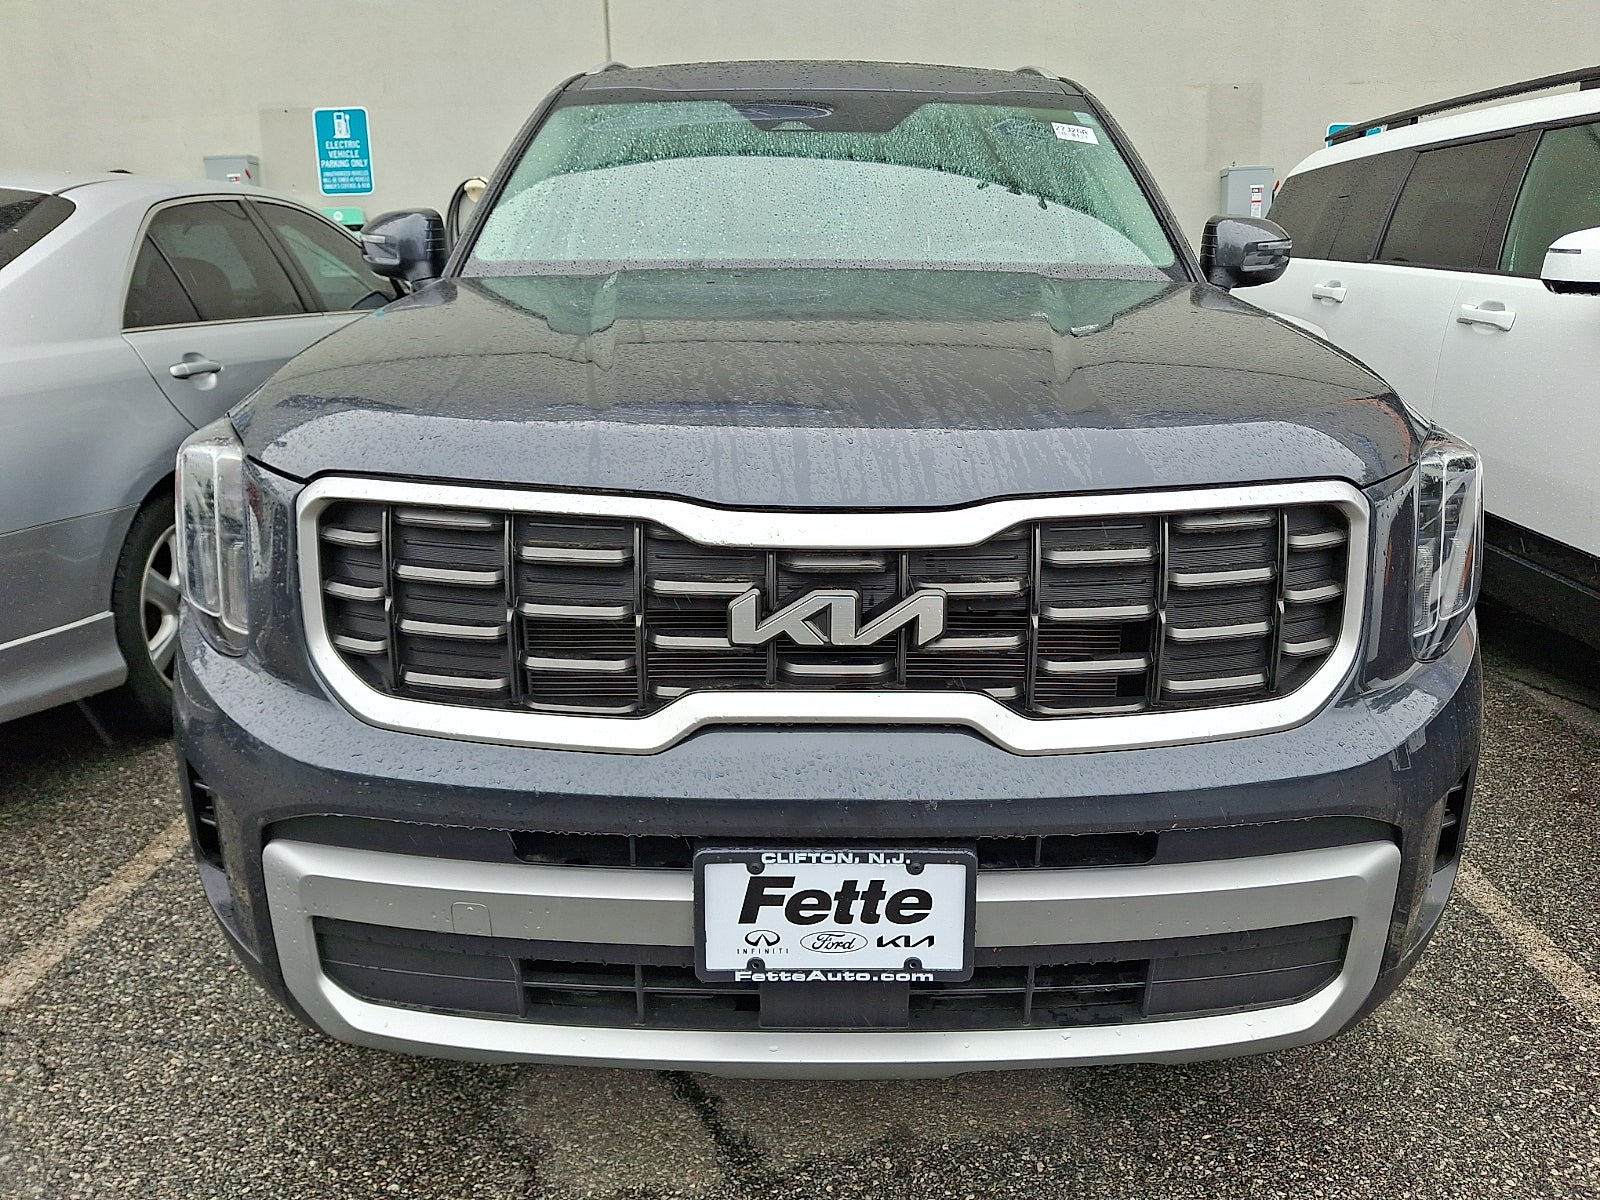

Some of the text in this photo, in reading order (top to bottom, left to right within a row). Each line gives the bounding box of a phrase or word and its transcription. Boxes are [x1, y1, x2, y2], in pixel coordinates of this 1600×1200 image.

[325, 140, 361, 150] ELECTRIC
[328, 149, 360, 158] VEHICLE
[320, 158, 368, 168] PARKING ONLY
[728, 588, 947, 646] KIA
[761, 852, 911, 864] CLIFTON, N.J.
[738, 876, 933, 925] Fette
[811, 933, 856, 950] Ford
[876, 935, 935, 948] KIA
[734, 970, 935, 982] FetteAuto.com
